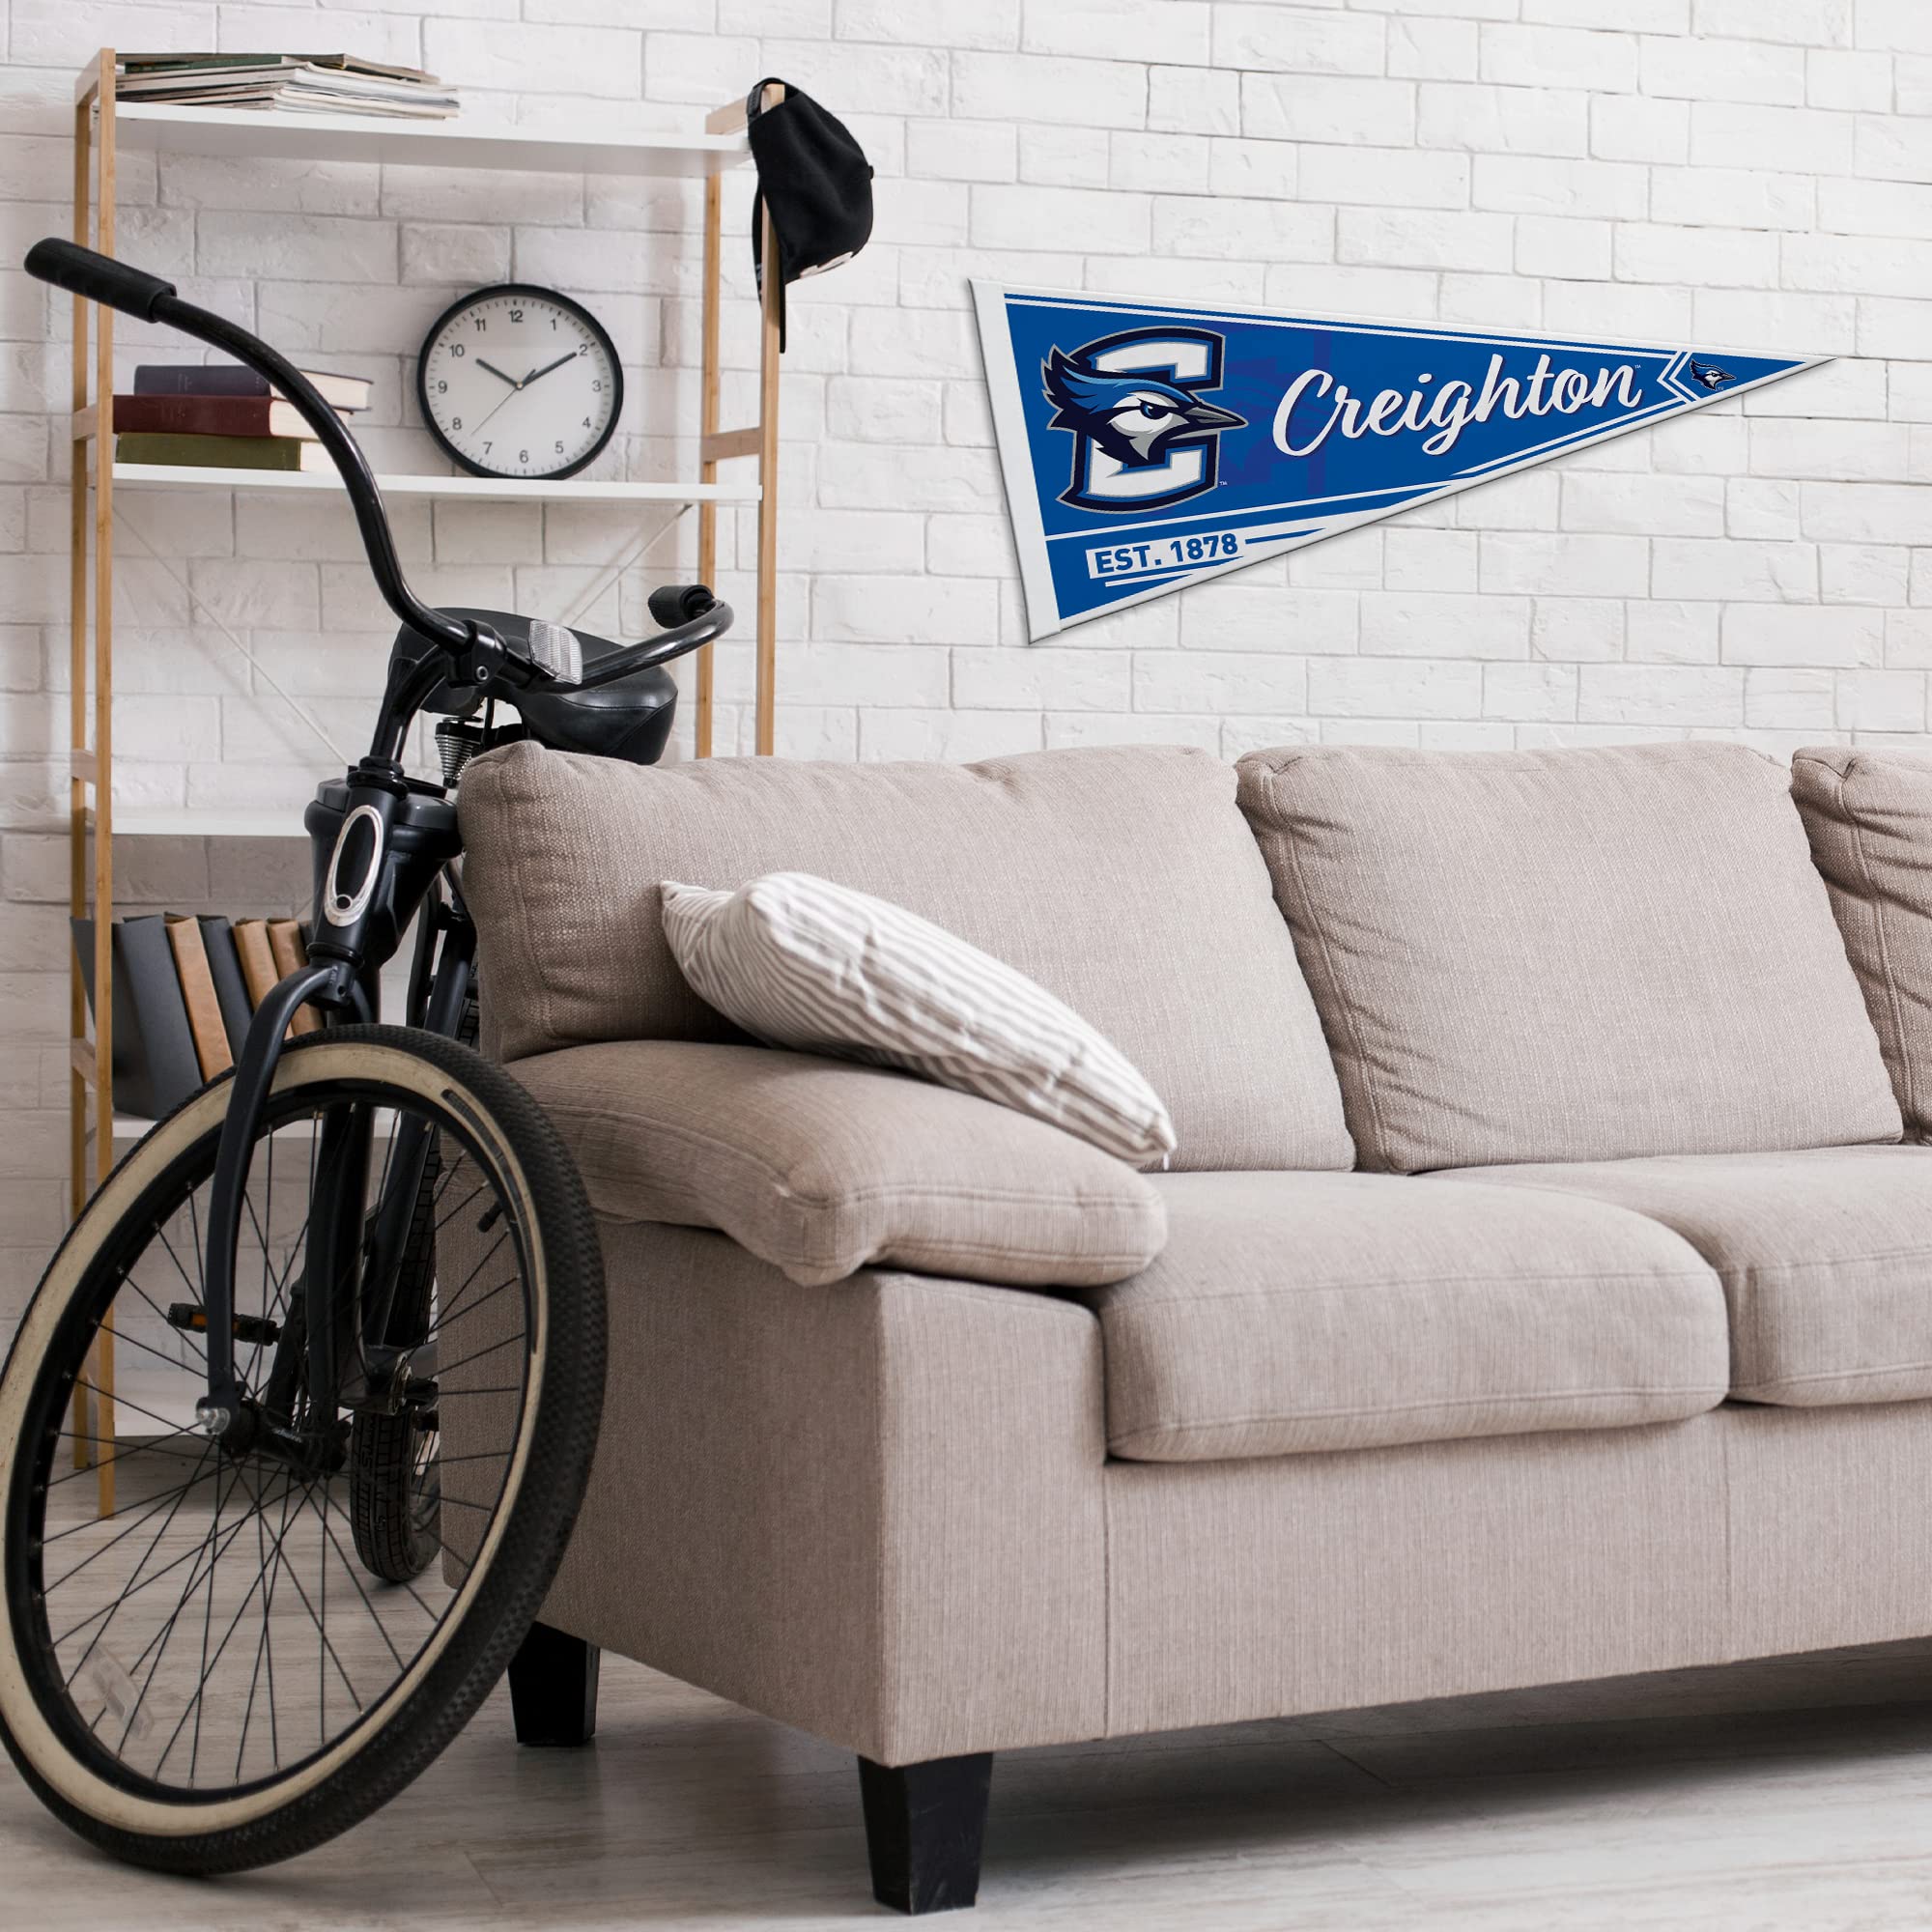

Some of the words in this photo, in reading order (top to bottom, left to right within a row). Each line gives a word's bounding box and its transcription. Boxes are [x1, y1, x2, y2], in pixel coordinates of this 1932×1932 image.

[508, 309, 524, 324] 12
[474, 319, 486, 331] 11
[551, 319, 556, 331] 1
[449, 343, 465, 357] 10
[580, 343, 588, 356] 2
[438, 380, 447, 394] 9
[592, 380, 602, 391] 3
[1272, 354, 1642, 456] Creighton
[452, 416, 463, 431] 8
[582, 417, 591, 428] 4
[483, 441, 493, 454] 7
[554, 440, 564, 454] 5
[519, 450, 528, 464] 6
[1094, 545, 1162, 574] EST.
[1171, 533, 1238, 562] 1878
